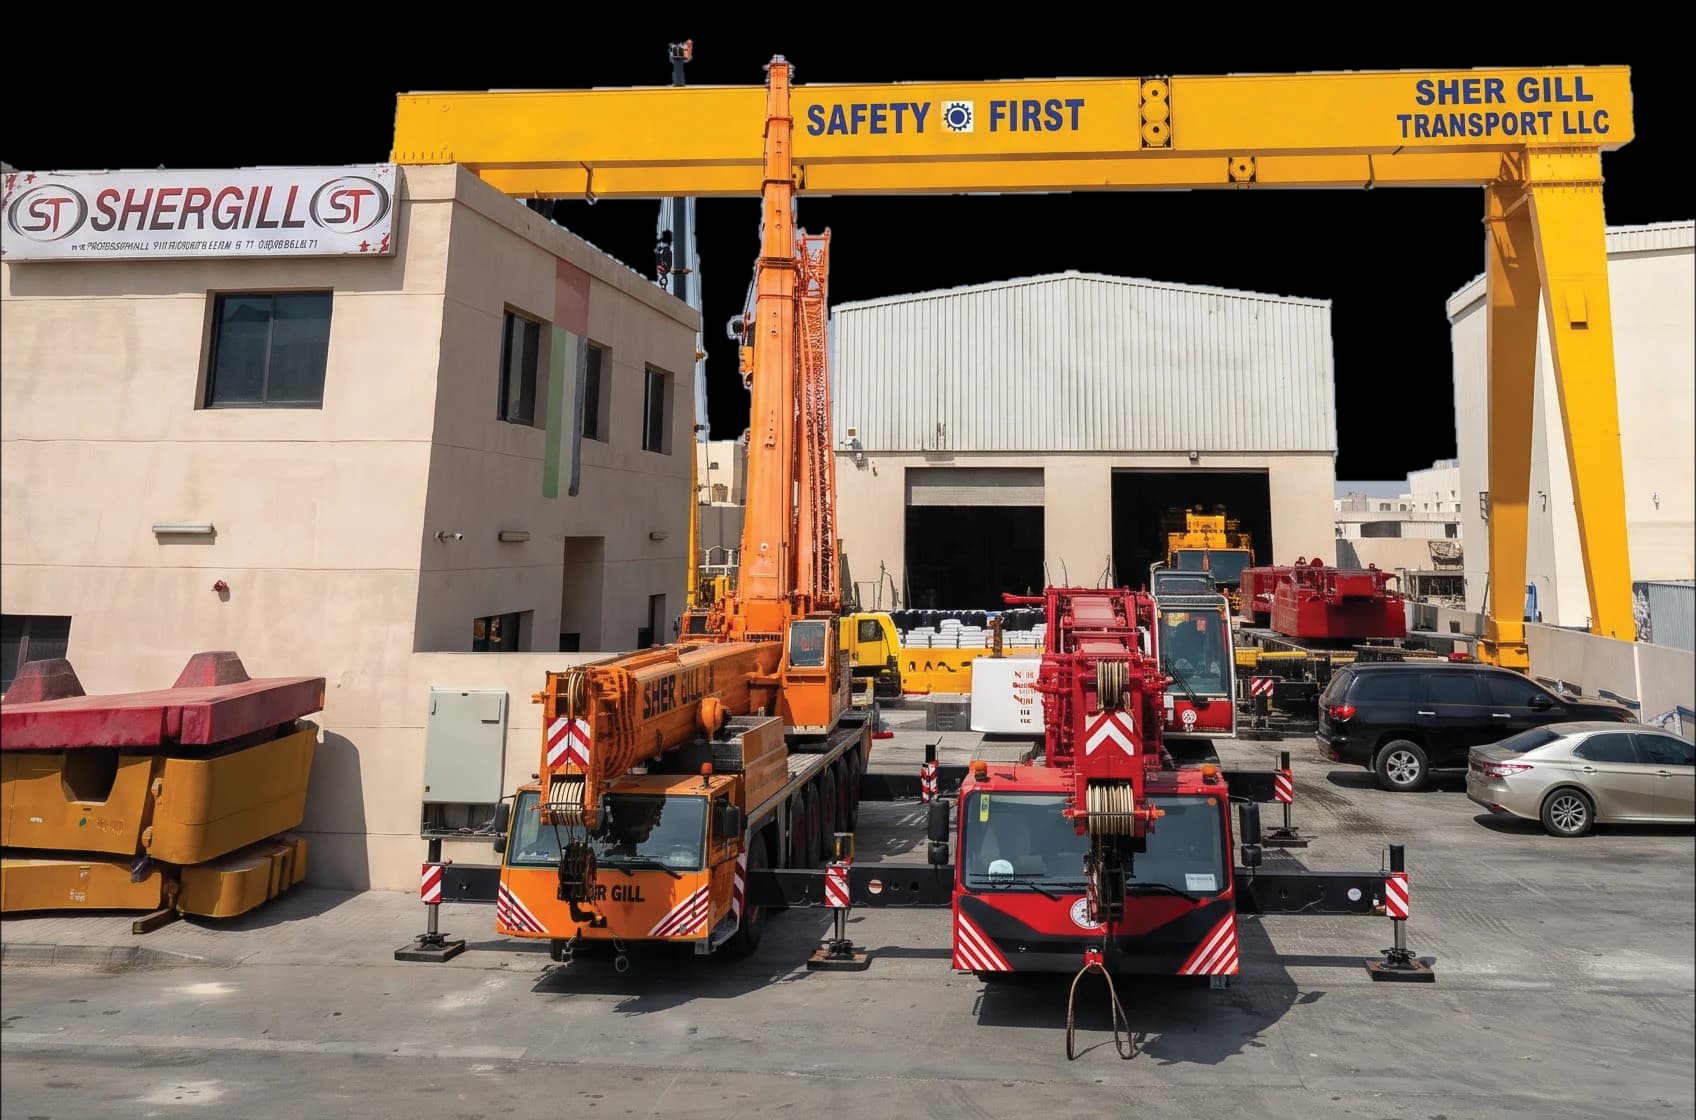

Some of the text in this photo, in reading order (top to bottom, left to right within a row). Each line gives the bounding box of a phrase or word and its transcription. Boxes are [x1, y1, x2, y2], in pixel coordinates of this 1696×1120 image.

[1416, 76, 1594, 105] SHER GILL
[806, 99, 1085, 136] SAFETY FIRST
[1397, 109, 1610, 138] TRANSPORT LLC
[22, 185, 376, 233] ST SHERGILL ST
[642, 673, 677, 720] SHER
[611, 885, 646, 902] GILL
